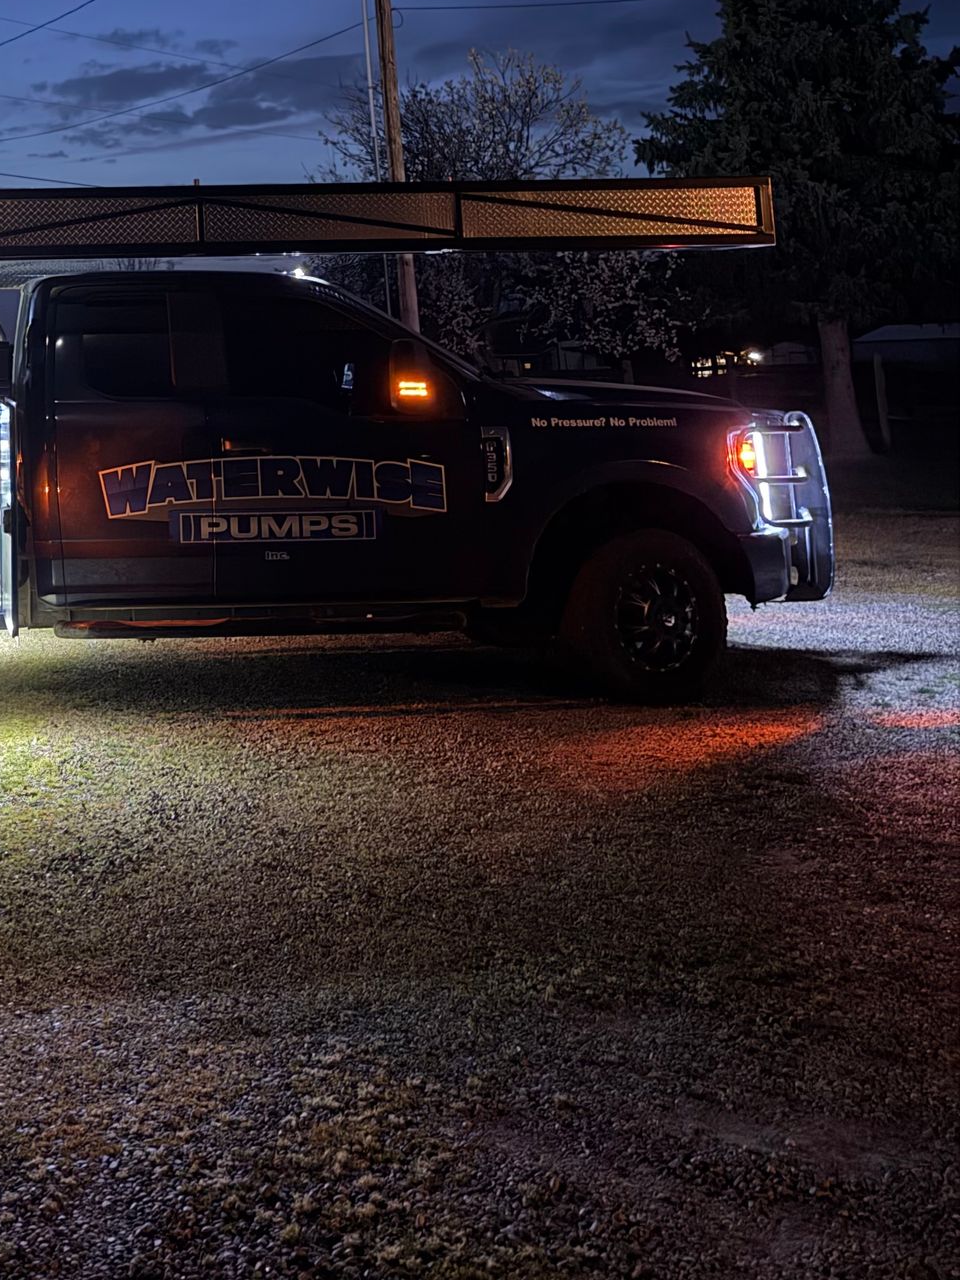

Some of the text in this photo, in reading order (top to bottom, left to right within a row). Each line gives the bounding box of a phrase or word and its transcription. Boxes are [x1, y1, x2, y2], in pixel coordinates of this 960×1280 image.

[531, 417, 677, 427] No Pressure? No Problem!
[98, 456, 447, 519] WATERWISE
[200, 515, 359, 539] PUMPS
[264, 550, 290, 561] Inc.
